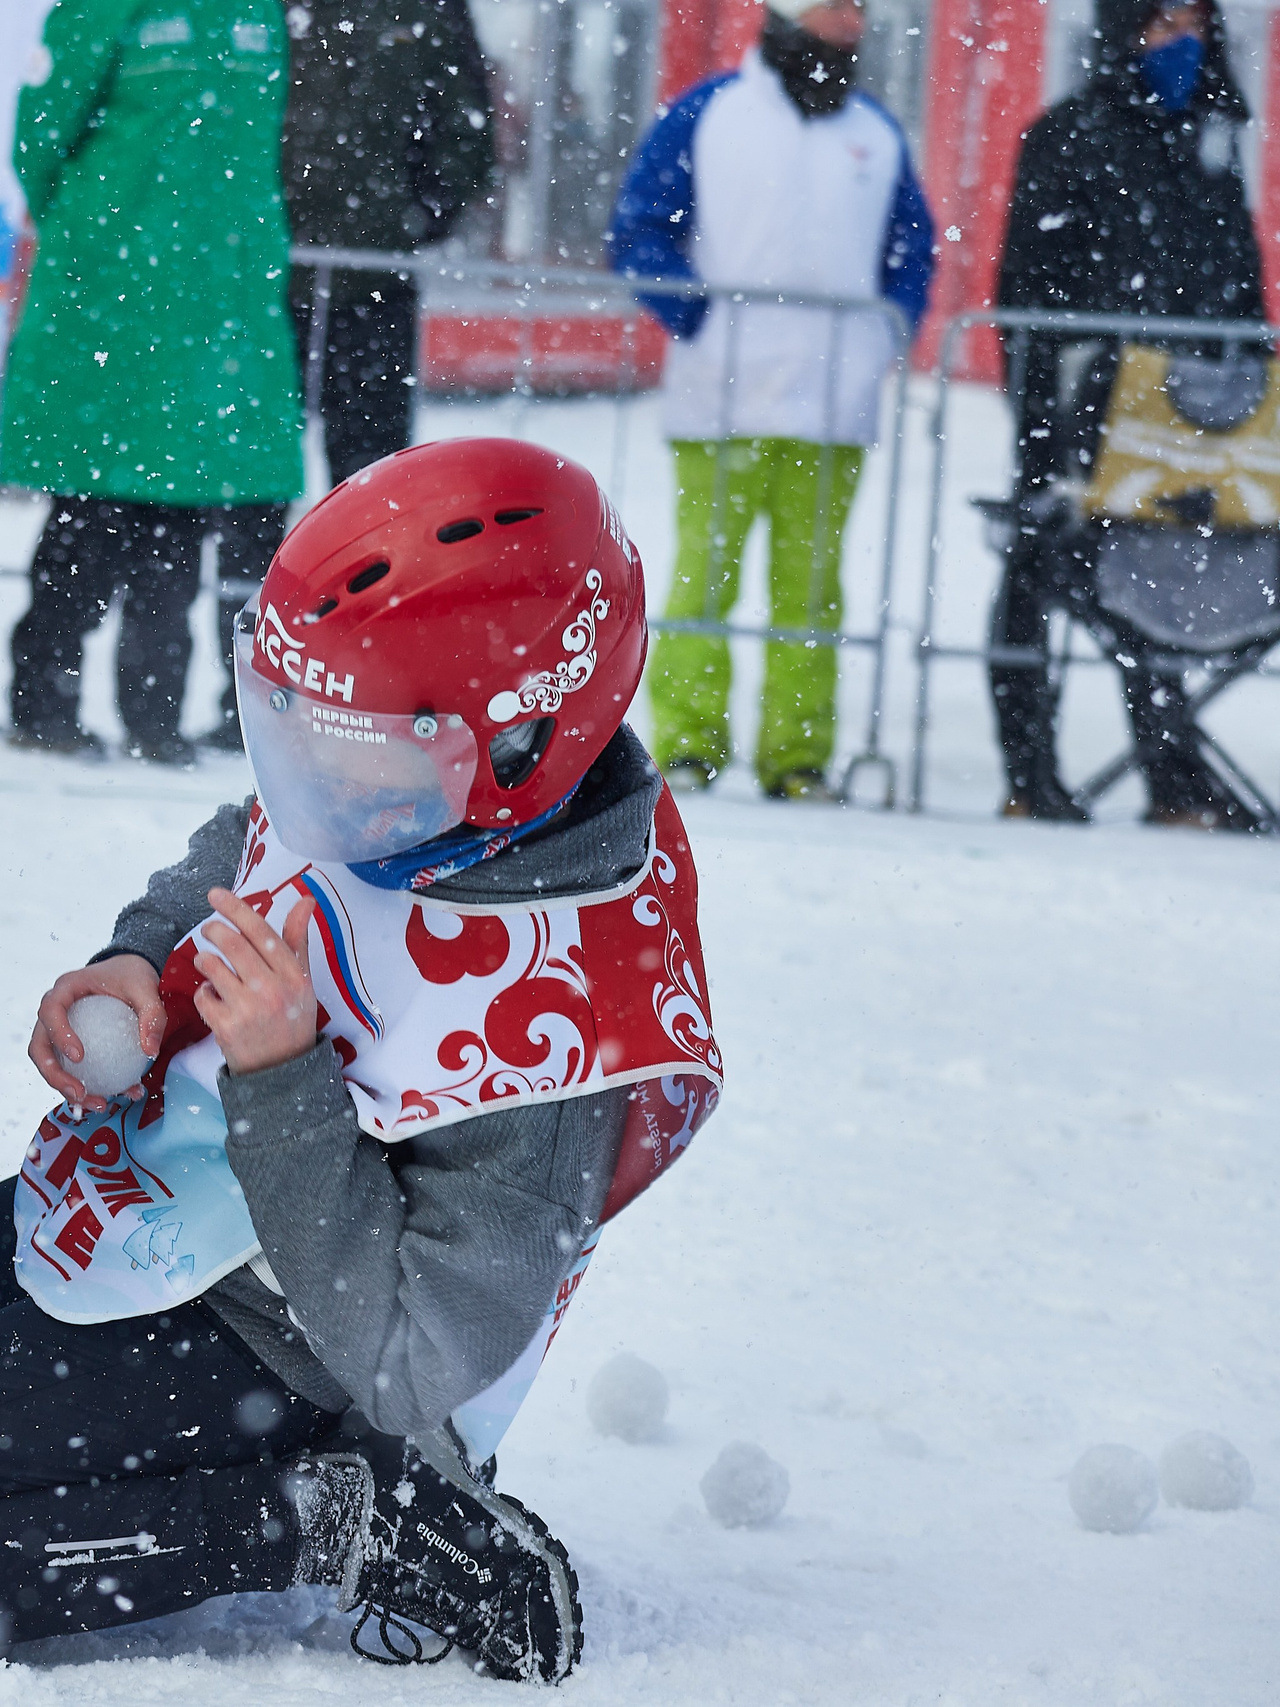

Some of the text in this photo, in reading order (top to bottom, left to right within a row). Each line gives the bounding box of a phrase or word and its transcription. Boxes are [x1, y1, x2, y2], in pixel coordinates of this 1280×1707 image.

[312, 706, 373, 728] ПЕРВЫЕ
[312, 721, 387, 744] В РОССИИ
[416, 1522, 479, 1576] Columbia
